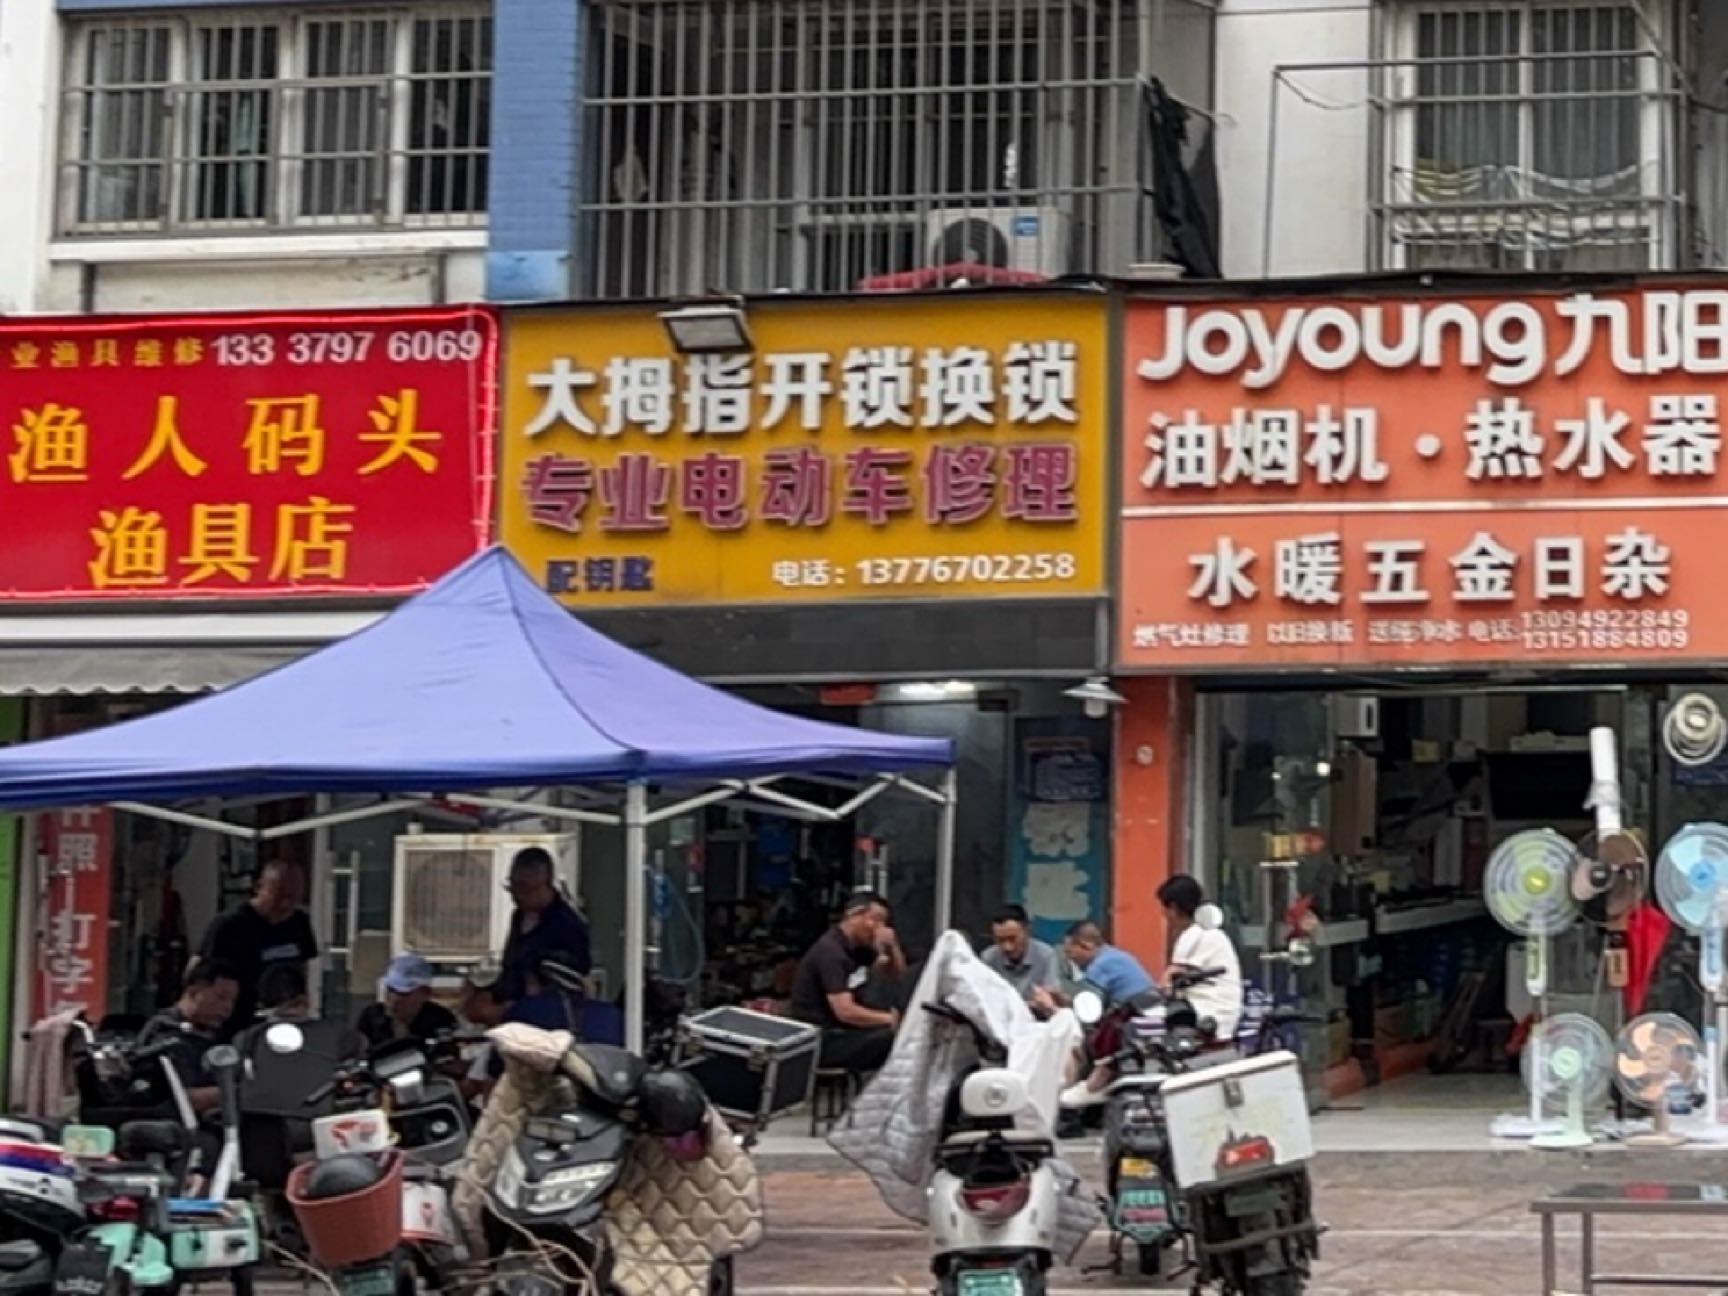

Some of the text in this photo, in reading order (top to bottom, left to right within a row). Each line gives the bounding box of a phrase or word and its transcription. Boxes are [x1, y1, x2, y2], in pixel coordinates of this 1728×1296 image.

[213, 334, 275, 366] 133
[288, 331, 374, 363] 3797
[388, 329, 482, 362] 6069
[524, 340, 1078, 437] 大拇指开锁换锁
[1137, 302, 1546, 390] Joyoung
[9, 389, 442, 483] 渔人码头
[522, 441, 1077, 533] 专业电动车修理
[88, 496, 356, 589] 渔具店
[545, 556, 655, 593] 配钥匙
[1187, 527, 1672, 607] 水暖五金日杂
